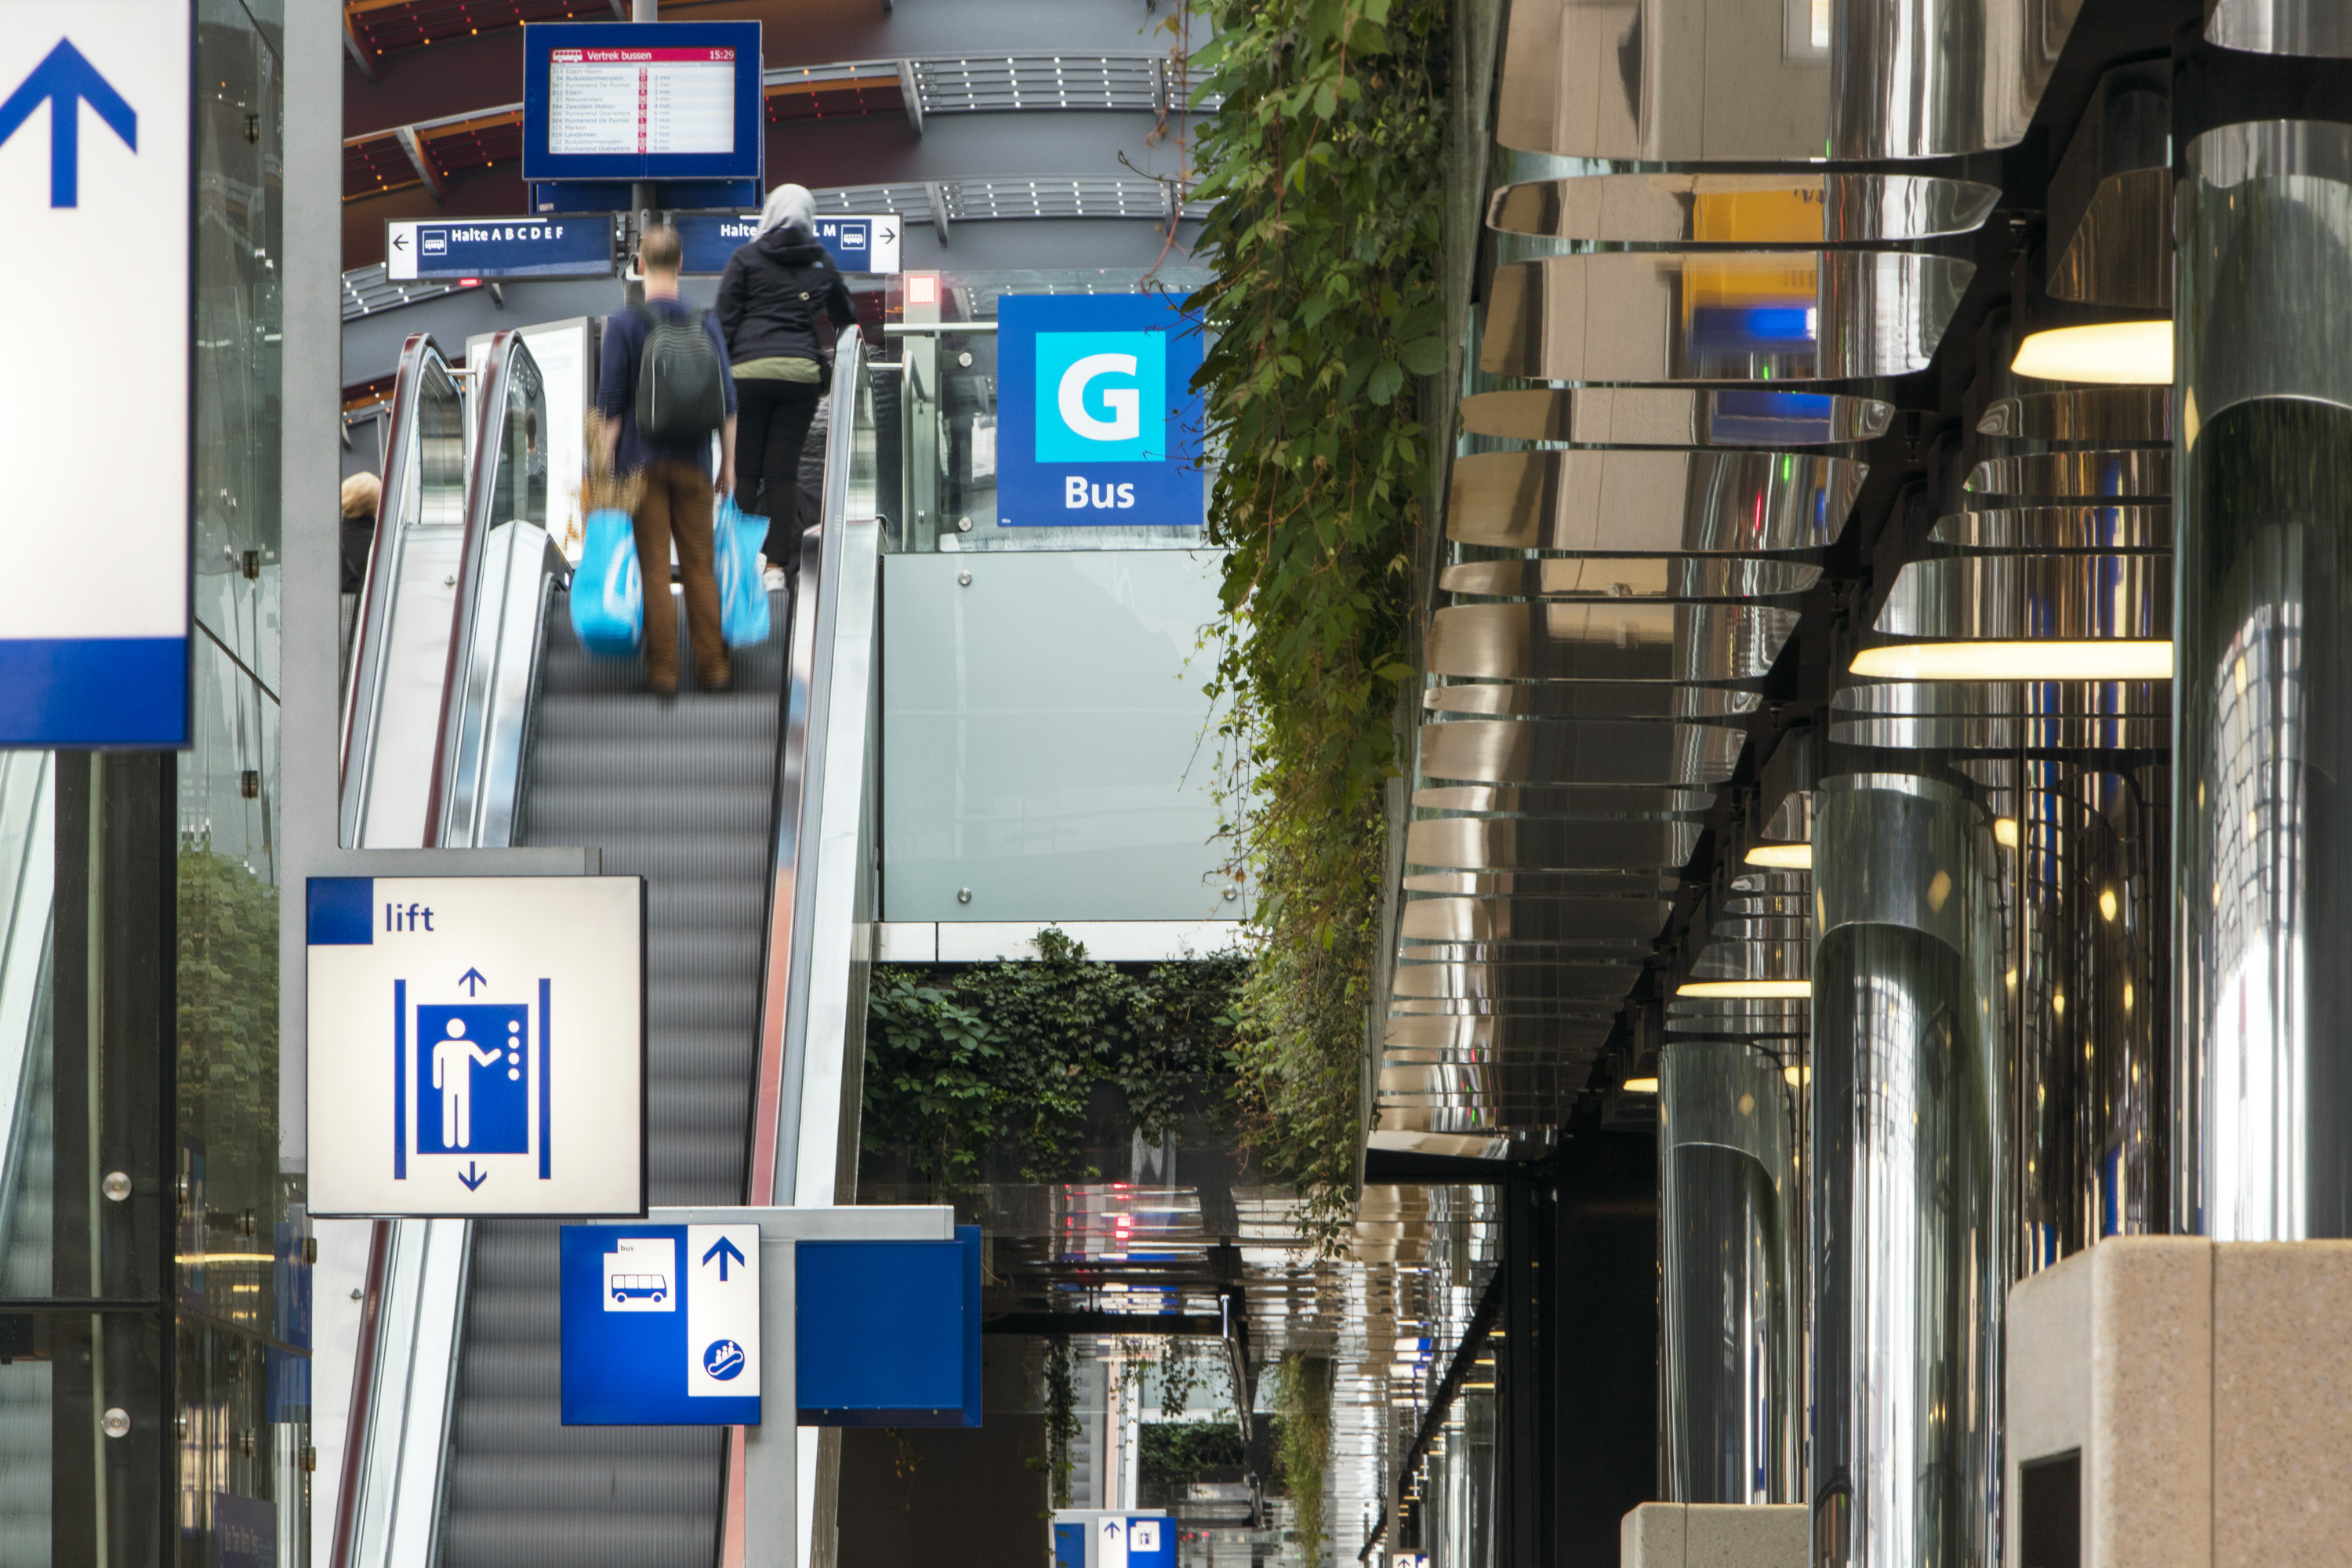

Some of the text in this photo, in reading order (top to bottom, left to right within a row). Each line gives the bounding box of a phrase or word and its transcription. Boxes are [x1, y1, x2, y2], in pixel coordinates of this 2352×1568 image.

[587, 49, 735, 60] Vertrek bussen 15:29
[452, 227, 563, 241] Halte A B C D E F
[720, 223, 836, 237] Halte L M
[1058, 353, 1139, 441] G
[1065, 476, 1135, 509] Bus
[387, 903, 434, 931] lift
